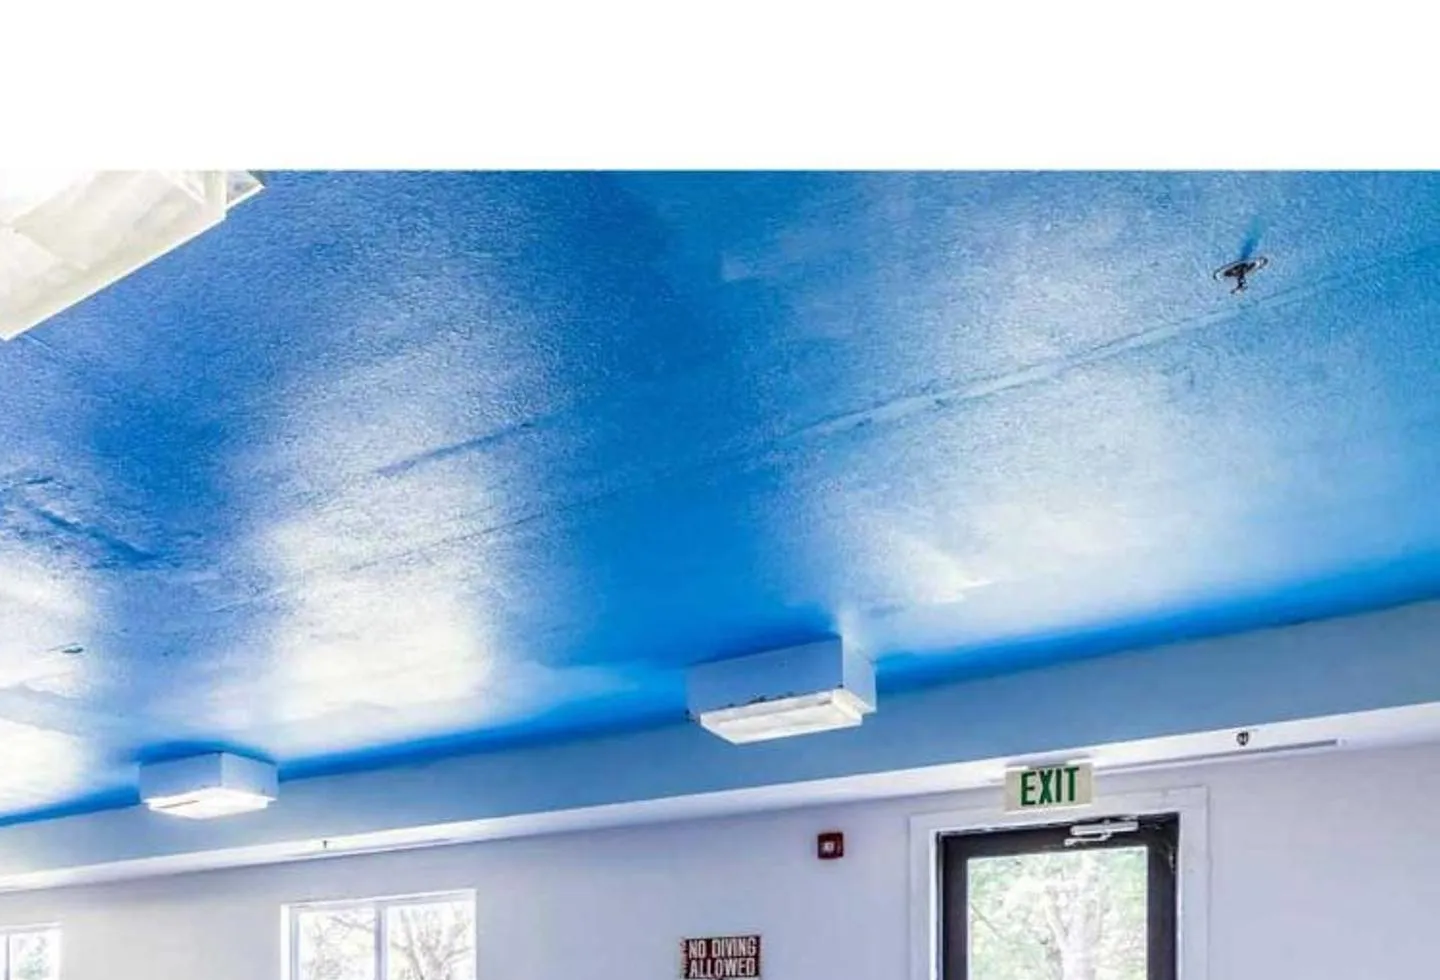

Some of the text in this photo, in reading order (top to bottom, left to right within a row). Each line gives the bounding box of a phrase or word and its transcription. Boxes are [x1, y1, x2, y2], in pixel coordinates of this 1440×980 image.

[1020, 766, 1079, 806] EXIT
[688, 937, 757, 959] NO DIVING
[689, 957, 756, 978] ALLOWED
